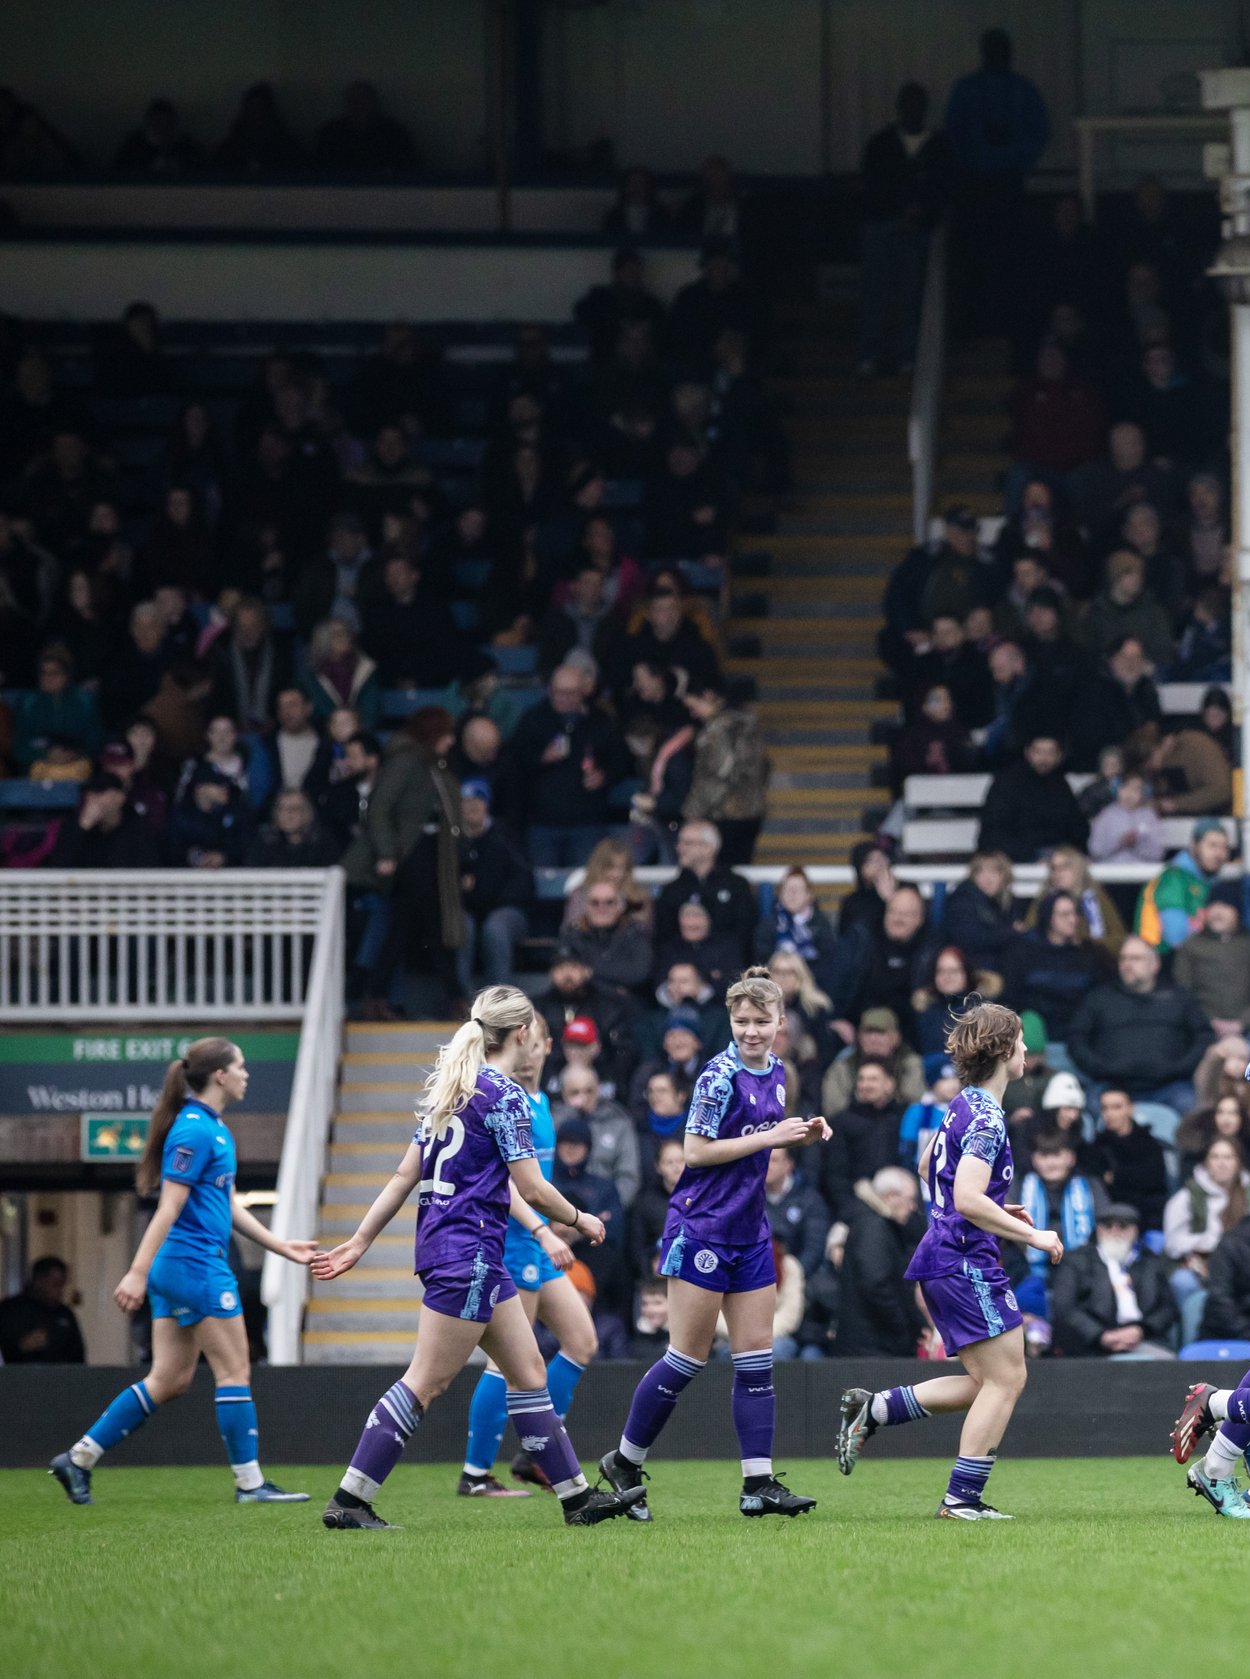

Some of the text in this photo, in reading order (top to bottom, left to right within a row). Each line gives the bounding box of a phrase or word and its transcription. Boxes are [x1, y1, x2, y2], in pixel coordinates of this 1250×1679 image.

[73, 1038, 120, 1061] FIRE
[125, 1038, 173, 1061] EXIT
[27, 1084, 123, 1111] Weston
[420, 1114, 465, 1196] 22
